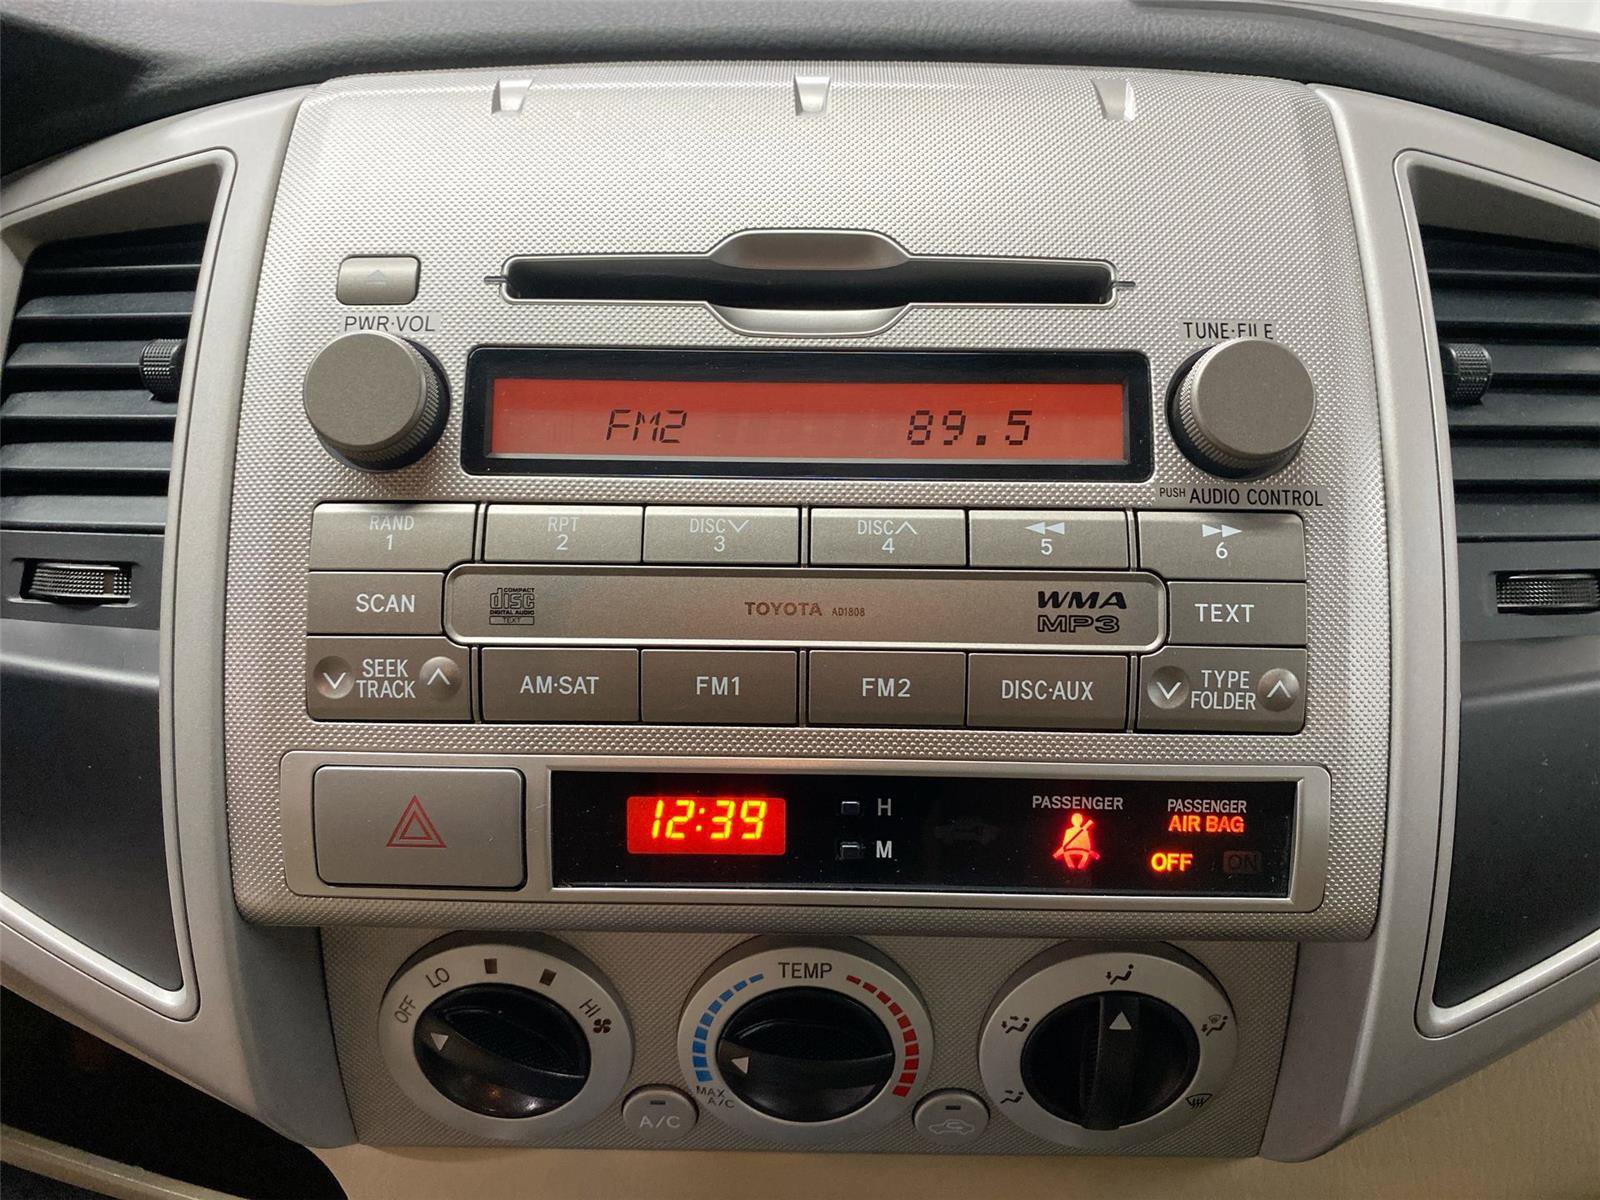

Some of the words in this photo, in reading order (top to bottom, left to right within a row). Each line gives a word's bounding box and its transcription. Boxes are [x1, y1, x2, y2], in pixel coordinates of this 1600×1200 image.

[606, 410, 688, 443] FM2
[907, 410, 1033, 445] 89.5
[1159, 487, 1186, 498] PUSH
[1189, 488, 1240, 504] AUDIO
[1246, 489, 1324, 507] CONTROL
[369, 515, 415, 531] RAND
[548, 516, 579, 532] RPT
[690, 518, 726, 534] DISC
[857, 519, 894, 535] DISC
[385, 534, 394, 550] 1
[556, 534, 569, 550] 2
[713, 536, 725, 552] 3
[881, 538, 895, 554] 4
[1040, 539, 1053, 555] 5
[1216, 542, 1229, 559] 6
[355, 594, 416, 613] SCAN
[744, 601, 823, 616] TOYOTA
[832, 607, 866, 617] AD1808
[1037, 591, 1127, 610] WMA
[1194, 603, 1255, 623] TEXT
[1037, 614, 1120, 634] MP3
[362, 659, 408, 678] SEEK
[696, 676, 740, 696] FM1
[862, 677, 911, 698] FM2
[1200, 670, 1250, 689] TYPE
[356, 680, 416, 699] TRACK
[1190, 691, 1256, 711] FOLDER
[877, 799, 892, 817] H
[1032, 795, 1124, 811] PASSENGER
[1167, 798, 1248, 813] PASSENGER
[651, 799, 767, 840] 12:39
[1168, 815, 1201, 832] AIR
[1205, 815, 1245, 833] BAG
[875, 840, 893, 859] M
[1151, 852, 1193, 873] OFF
[424, 967, 451, 989] LO
[778, 961, 833, 980] TEMP
[394, 995, 416, 1024] OFF
[579, 998, 601, 1018] HI
[696, 1085, 726, 1099] MAX
[708, 1097, 735, 1109] A/C
[638, 1115, 682, 1130] A/C
